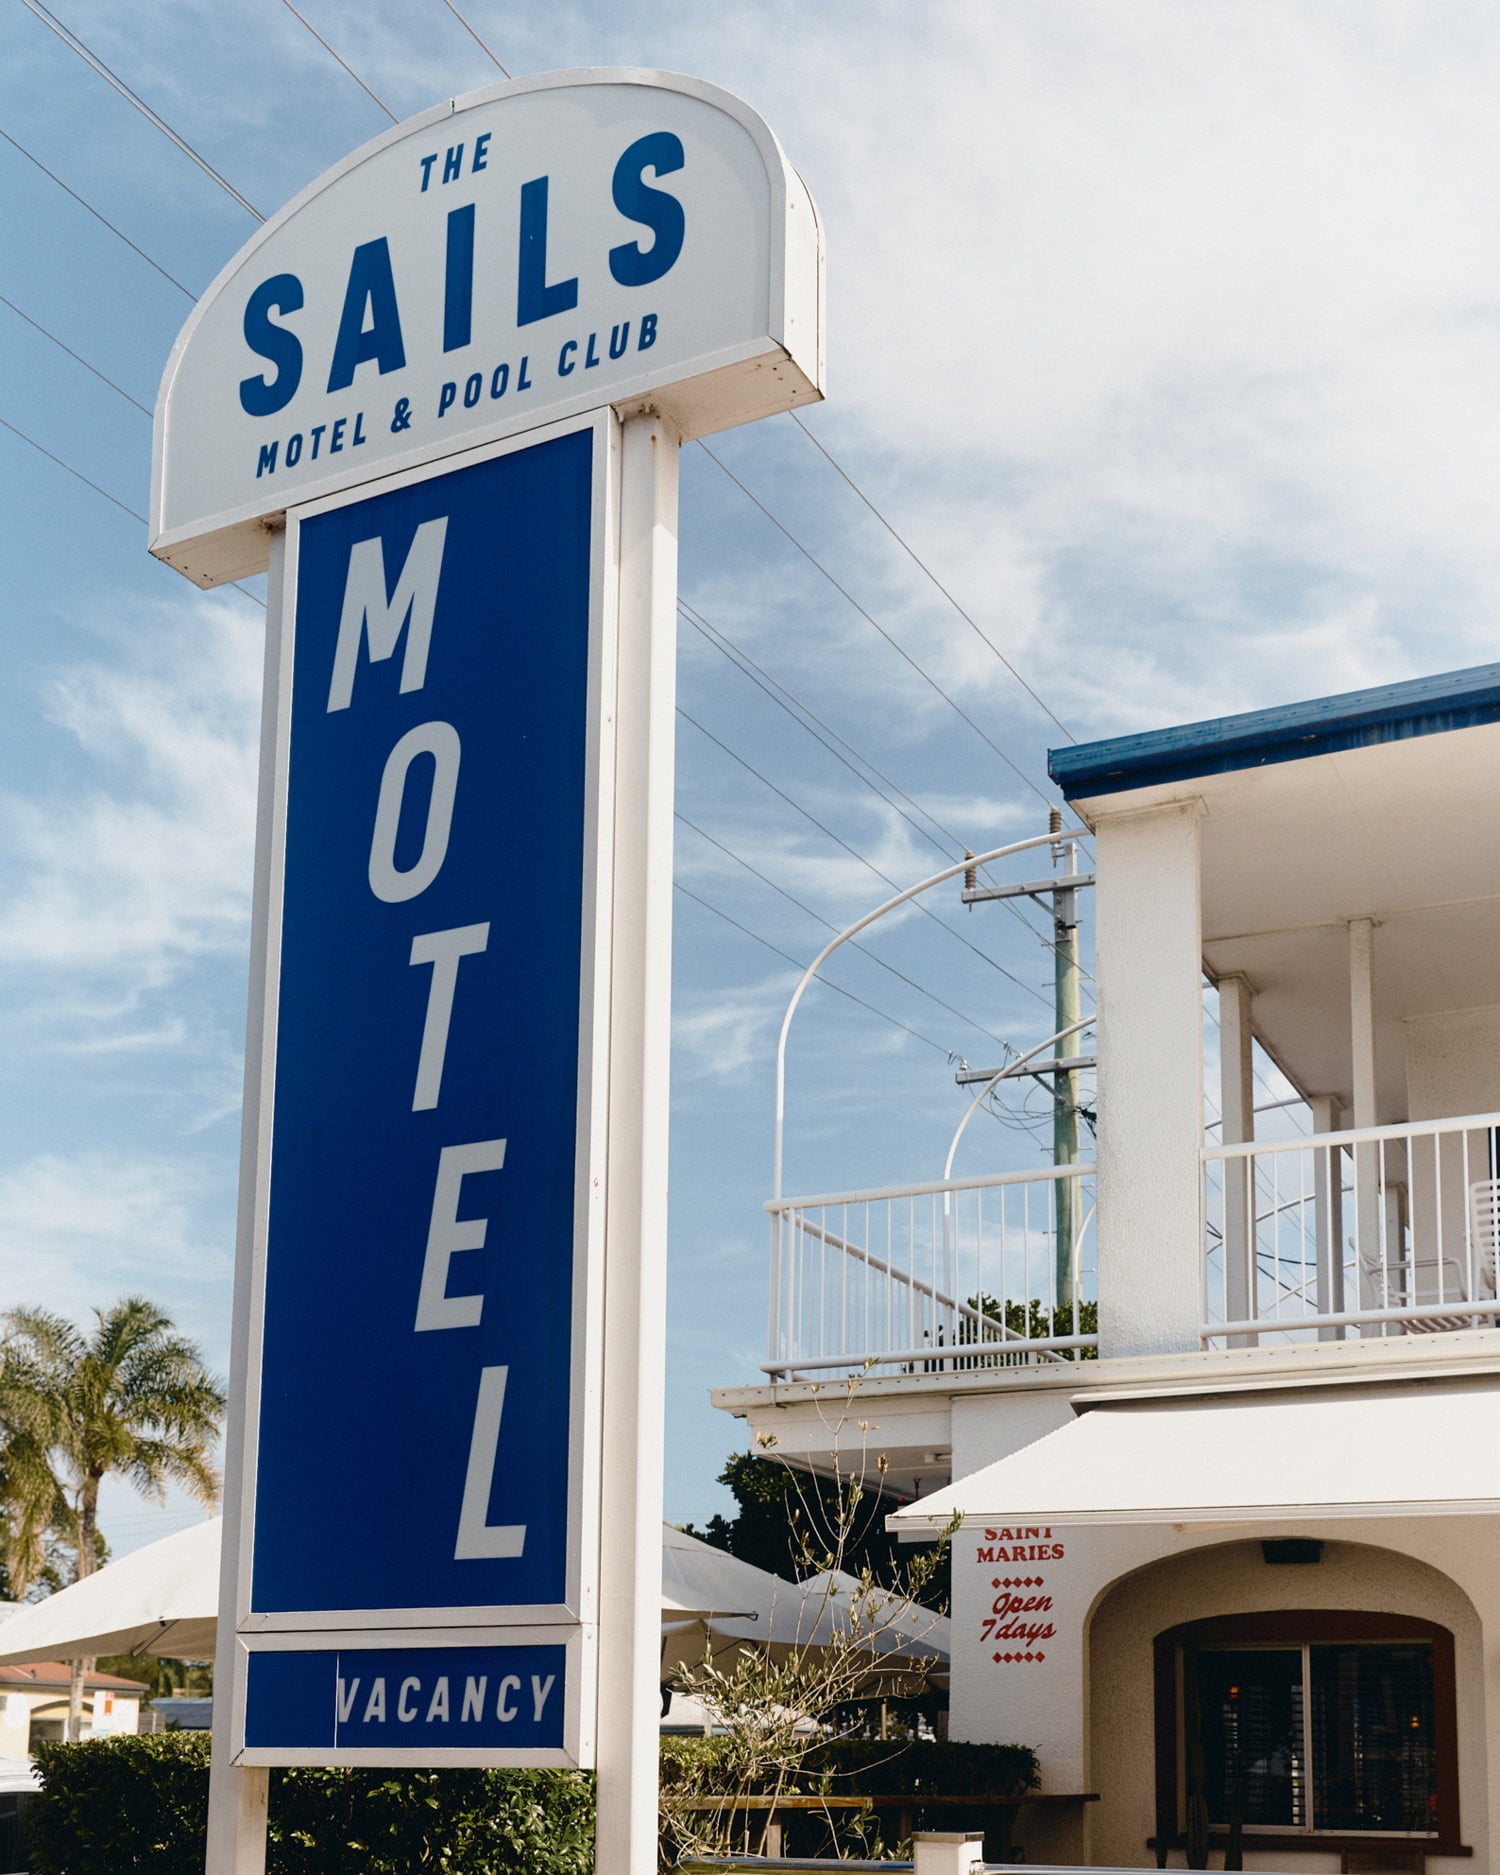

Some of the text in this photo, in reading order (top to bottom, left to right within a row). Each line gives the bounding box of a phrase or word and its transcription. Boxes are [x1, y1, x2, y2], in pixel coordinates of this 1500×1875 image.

[420, 132, 492, 193] THE
[239, 131, 686, 418] SAILS
[255, 313, 659, 479] MOTEL & POOL CLUB
[326, 515, 527, 1561] MOTEL
[976, 1544, 1065, 1563] MARIES
[984, 1527, 1053, 1541] SAINT
[992, 1592, 1053, 1620] Open
[337, 1675, 556, 1723] VACANCY
